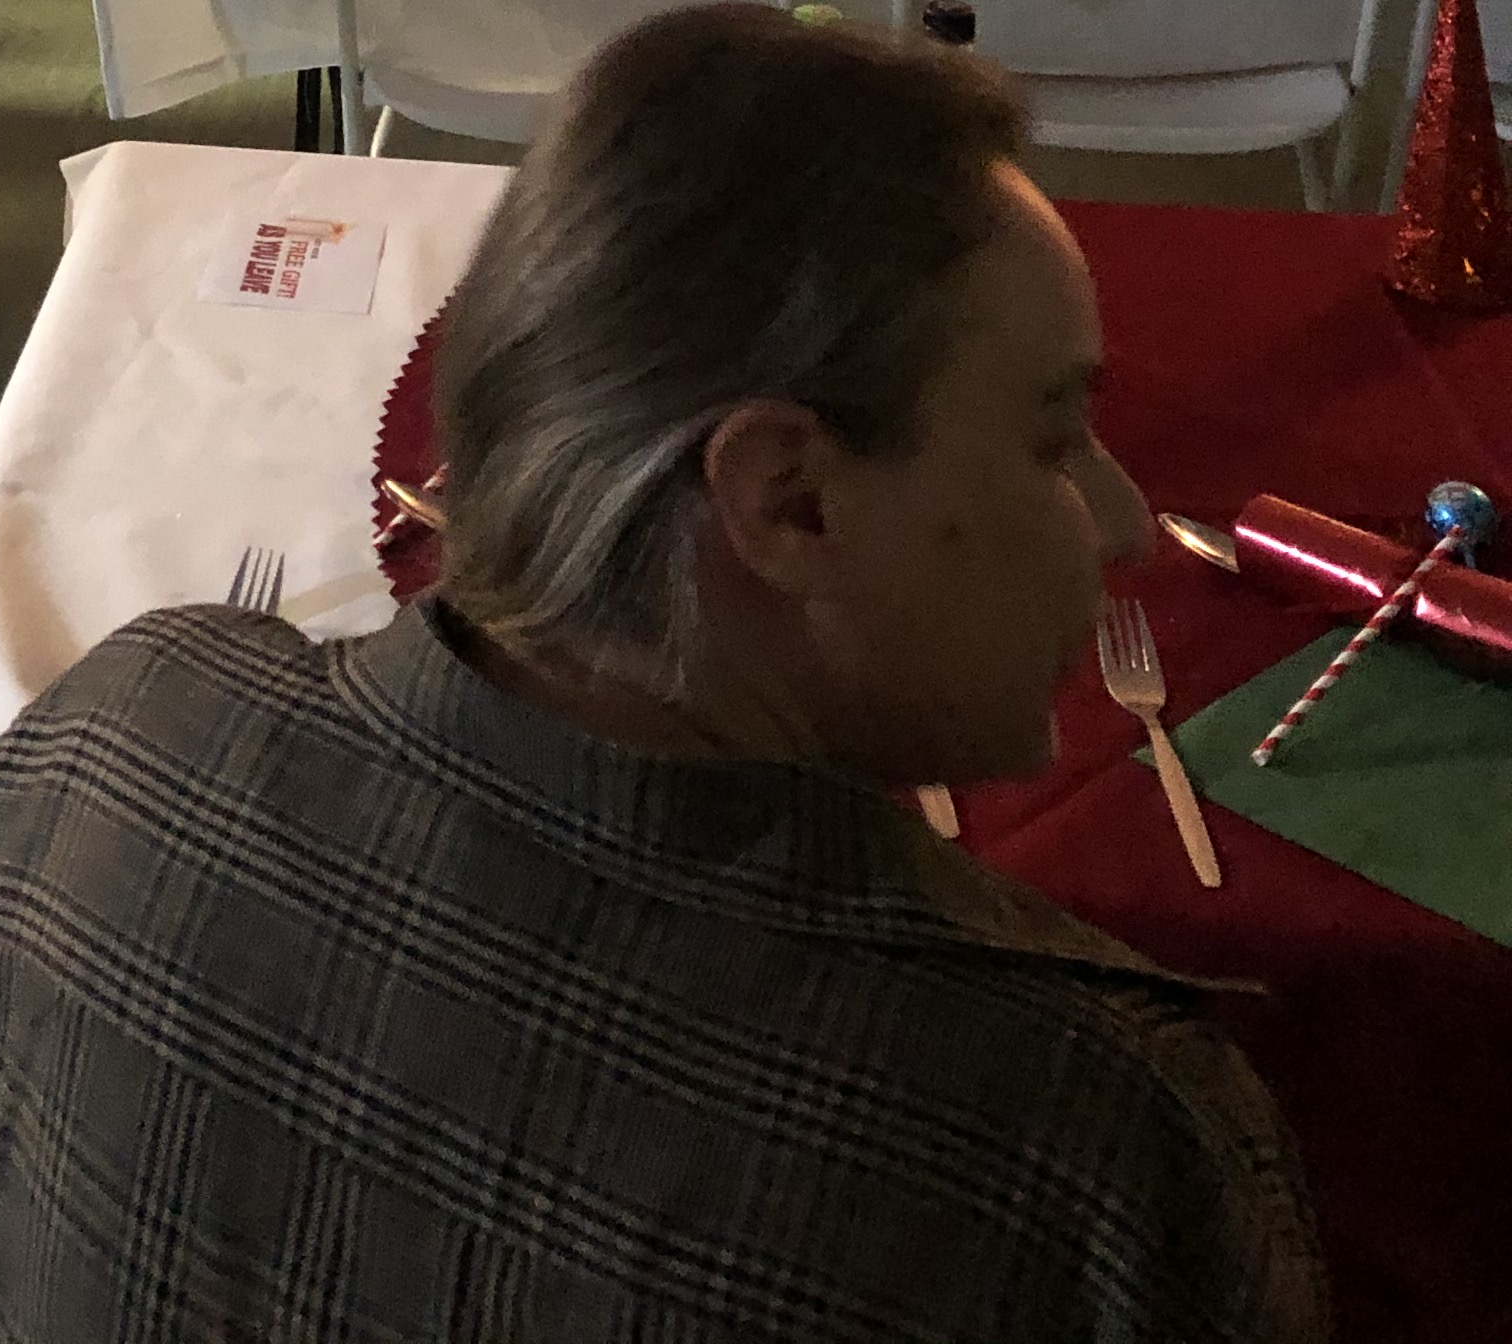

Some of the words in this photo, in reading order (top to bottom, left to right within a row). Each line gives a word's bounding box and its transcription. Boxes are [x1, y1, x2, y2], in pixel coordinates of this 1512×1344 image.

[256, 223, 287, 238] AS
[249, 240, 284, 261] YOU
[285, 240, 309, 268] FREE
[240, 260, 277, 295] LEAVE
